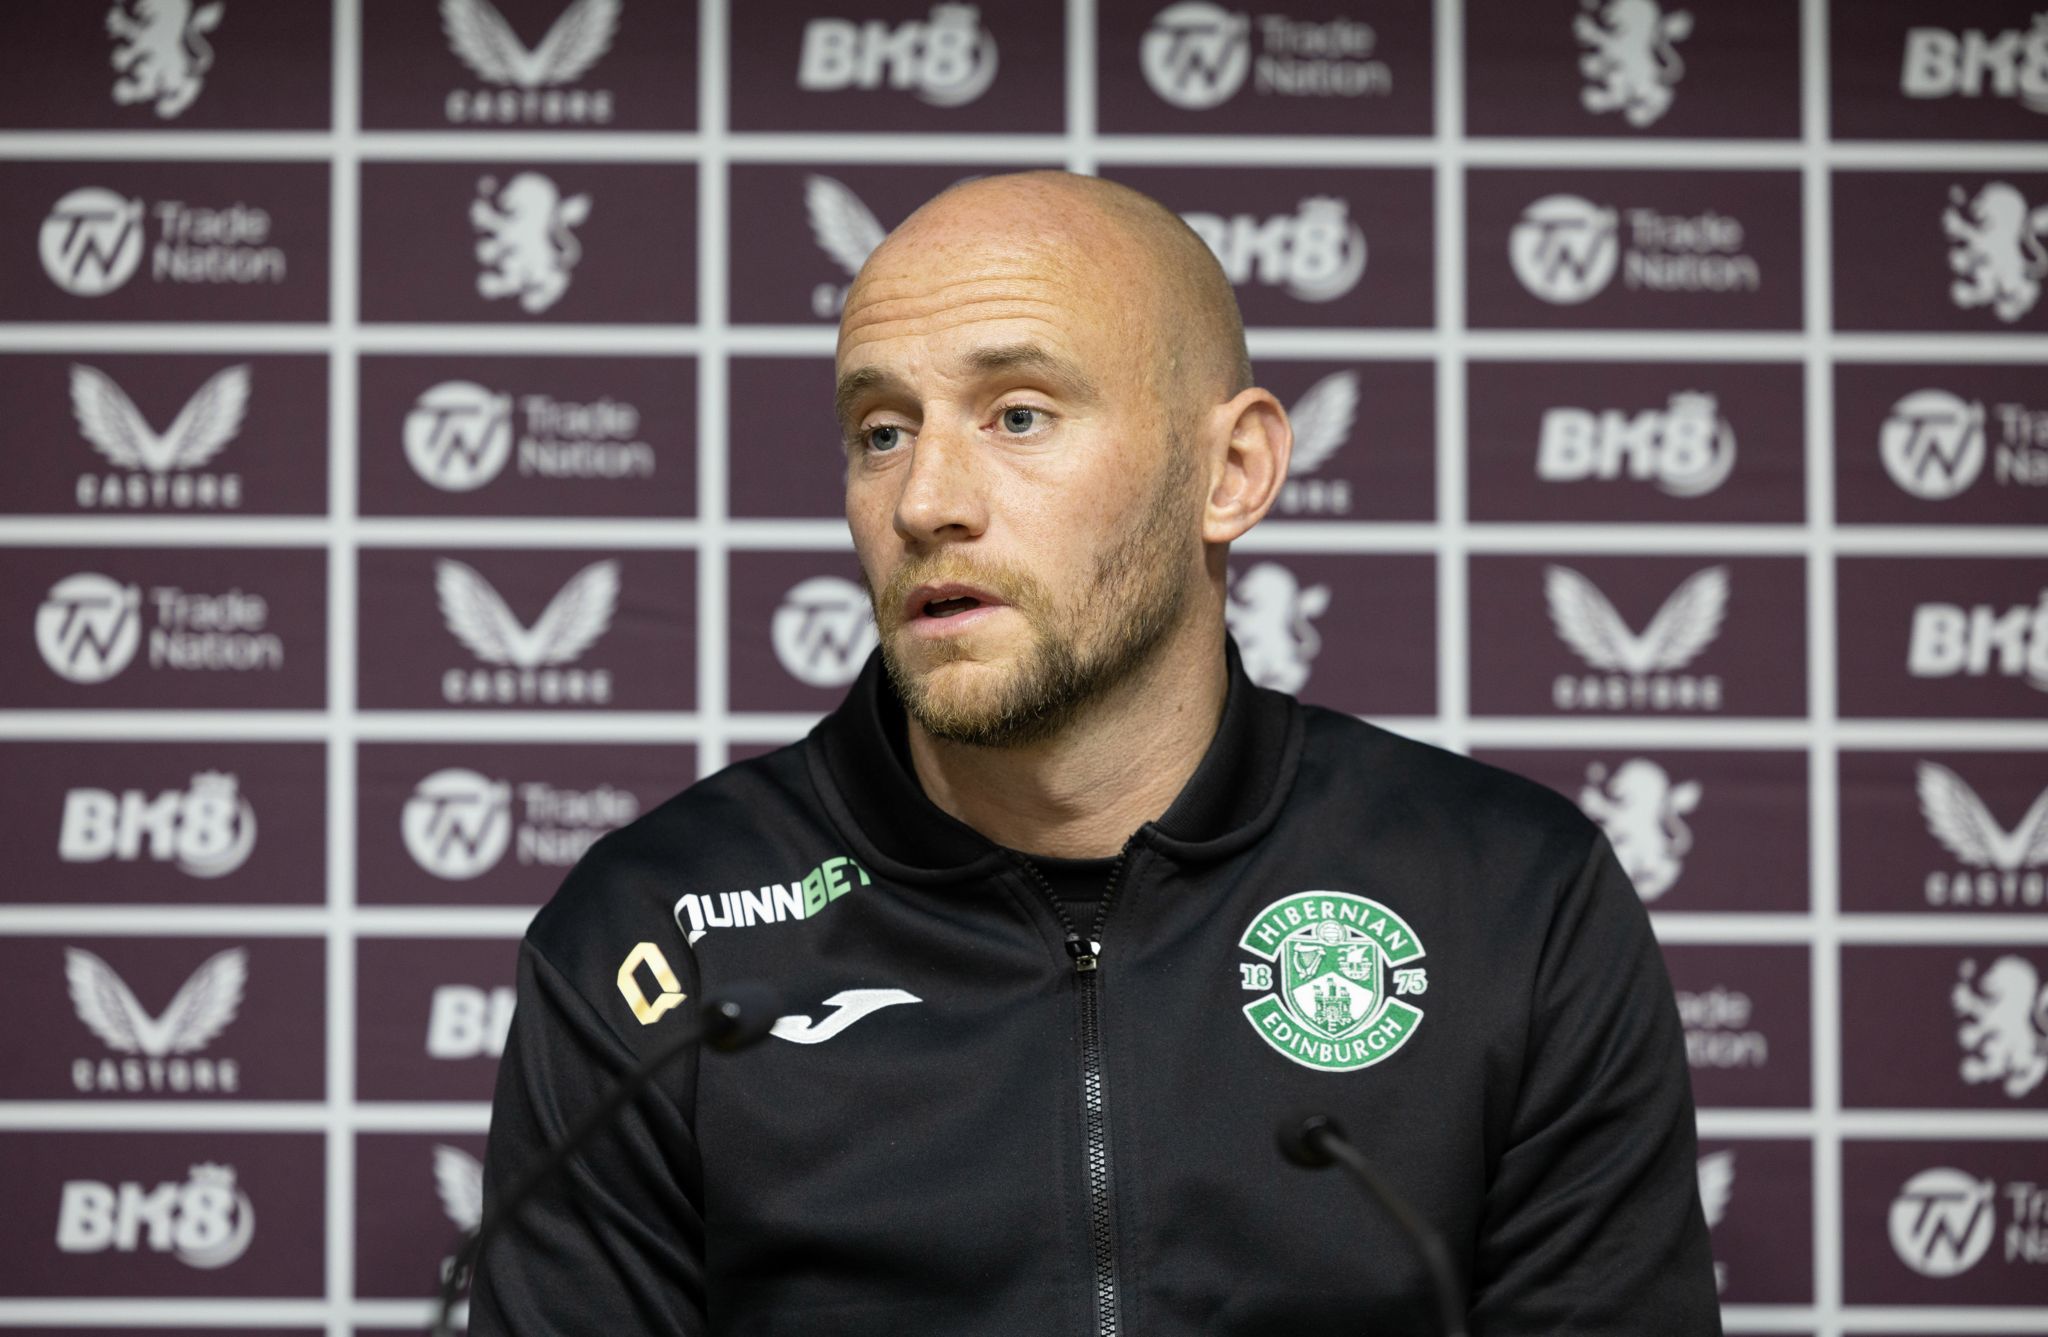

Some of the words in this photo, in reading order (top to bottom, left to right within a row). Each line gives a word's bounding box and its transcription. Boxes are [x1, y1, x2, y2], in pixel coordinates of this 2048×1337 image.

[798, 15, 990, 99] BK8
[1257, 14, 1376, 57] Trade
[1255, 58, 1392, 97] Nation
[155, 201, 271, 243] Trade
[1626, 207, 1744, 250] Trade
[152, 243, 287, 283] Nation
[1624, 251, 1760, 291] Nation
[521, 394, 639, 437] Trade
[517, 438, 655, 478] Nation
[1537, 402, 1728, 488] BK8
[151, 586, 268, 630] Trade
[149, 631, 284, 670] Nation
[59, 783, 249, 868] BK8
[519, 782, 639, 827] Trade
[1256, 900, 1409, 951] HIBERNIAN
[1239, 963, 1273, 990] 18
[1392, 968, 1428, 995] 75
[1262, 1011, 1403, 1063] EDINBURGH
[57, 1173, 247, 1259] BK8
